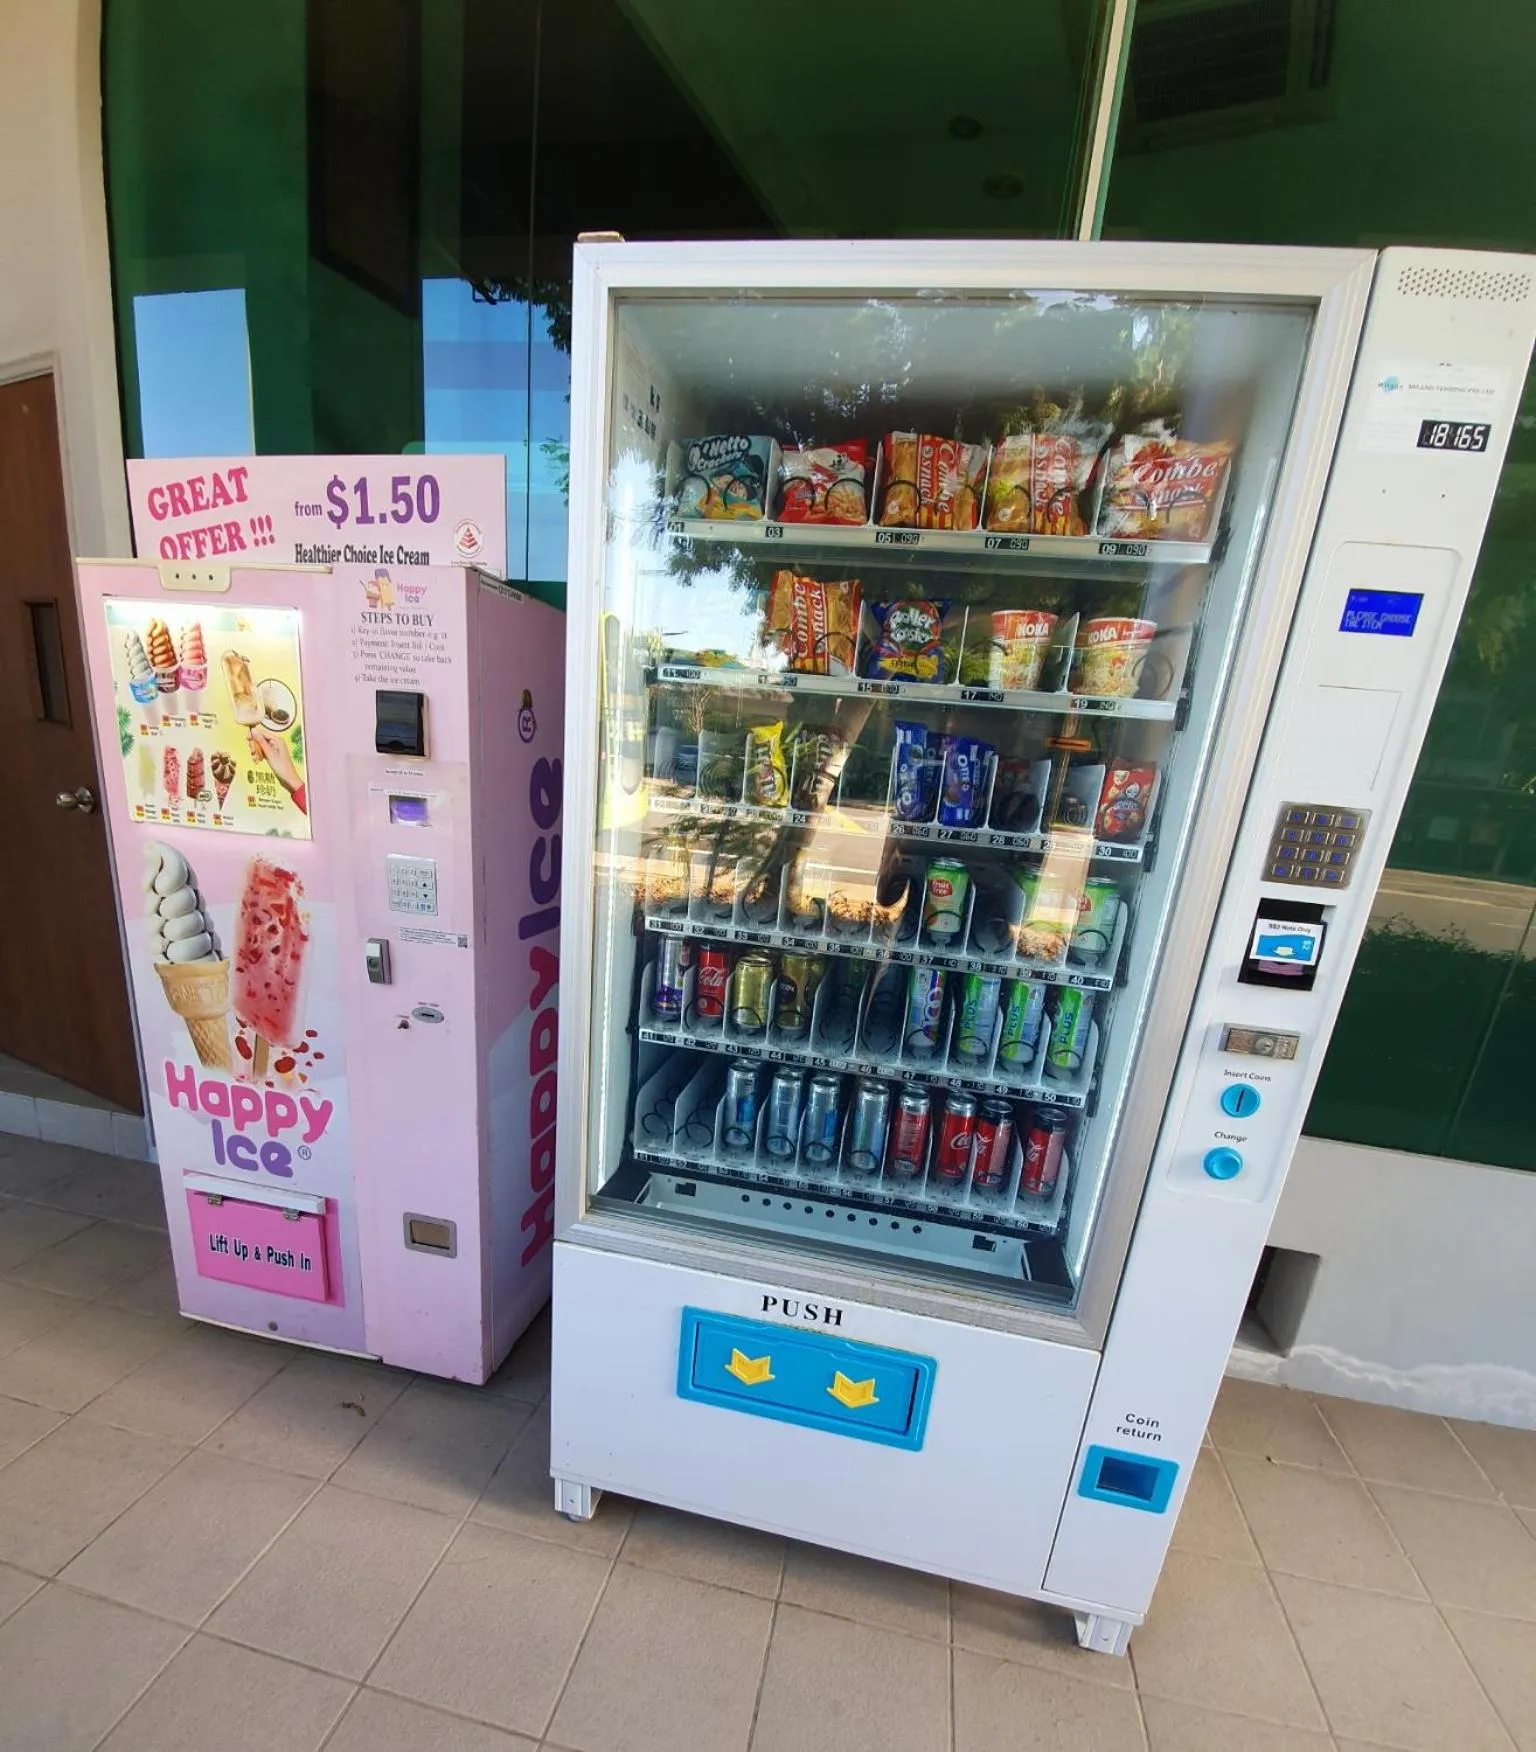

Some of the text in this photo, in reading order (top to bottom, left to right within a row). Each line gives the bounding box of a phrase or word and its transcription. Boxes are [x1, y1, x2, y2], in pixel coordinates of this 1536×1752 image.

[148, 466, 249, 522] GREAT
[294, 474, 441, 530] from $1.50
[159, 521, 248, 561] OFFER
[767, 527, 781, 538] 03
[878, 533, 892, 543] 05
[986, 538, 1001, 549] 07
[1101, 543, 1117, 555] 09
[295, 543, 342, 564] Healthier
[343, 544, 379, 565] Choice
[380, 544, 396, 566] Ice
[396, 545, 431, 567] Cream
[397, 583, 428, 596] Happy
[361, 611, 434, 627] STEPS TO BUY
[1016, 620, 1049, 637] KOKA
[1087, 627, 1118, 643] KOKA
[1074, 700, 1088, 710] 19
[517, 756, 562, 941] Ice
[1098, 846, 1112, 857] 30
[1281, 923, 1297, 932] Note
[1297, 925, 1312, 935] Only
[963, 999, 978, 1031] PLUS
[1006, 1003, 1022, 1037] PLUS
[1059, 1010, 1074, 1045] PLUS
[1223, 1068, 1272, 1082] Insert Coins
[163, 1060, 334, 1144] Happy
[1214, 1130, 1248, 1143] Change
[211, 1118, 294, 1179] Ice
[209, 1233, 313, 1272] Lift Up & Push In
[761, 1294, 844, 1327] PUSH
[1125, 1413, 1161, 1429] Coin
[1116, 1425, 1163, 1442] return
